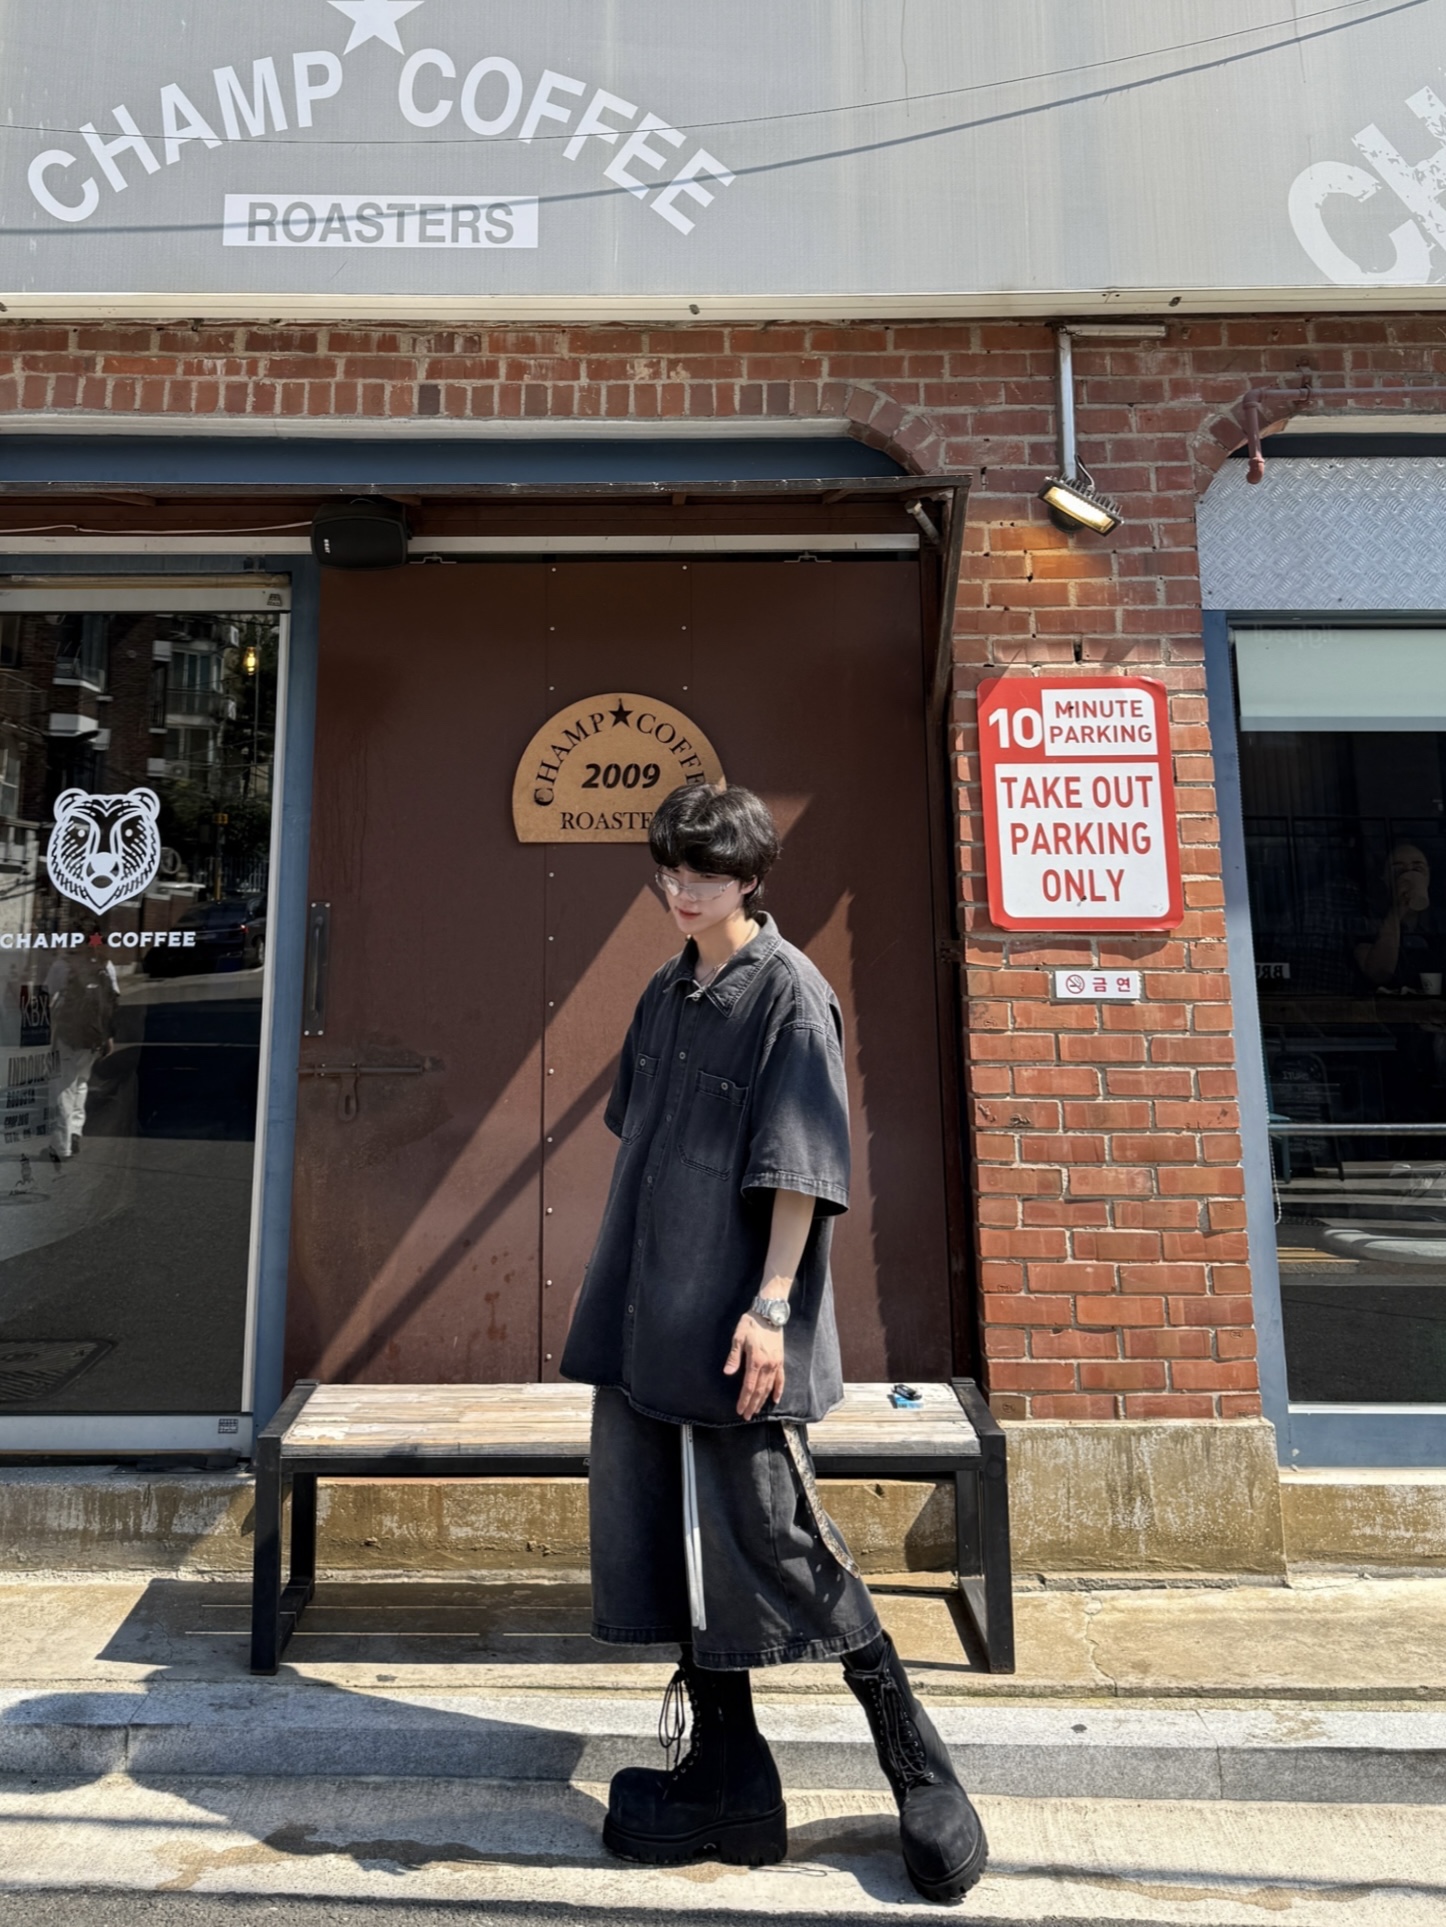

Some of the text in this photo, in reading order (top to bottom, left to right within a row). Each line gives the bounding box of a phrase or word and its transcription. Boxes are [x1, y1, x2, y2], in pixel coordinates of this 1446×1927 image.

[27, 47, 737, 237] CHAMP COFFEE
[247, 201, 515, 245] ROASTERS
[1055, 700, 1144, 719] MINUTE
[988, 707, 1043, 749] 10
[1050, 725, 1152, 744] PARKING
[533, 711, 706, 807] CHAMP COFFE
[581, 762, 661, 789] 2009
[1000, 775, 1153, 809] TAKE OUT
[560, 811, 654, 831] ROASTE
[1010, 821, 1152, 855] PARKING
[1042, 868, 1125, 903] ONLY
[0, 931, 197, 949] CHAMP COFFEE
[21, 994, 51, 1029] KBX
